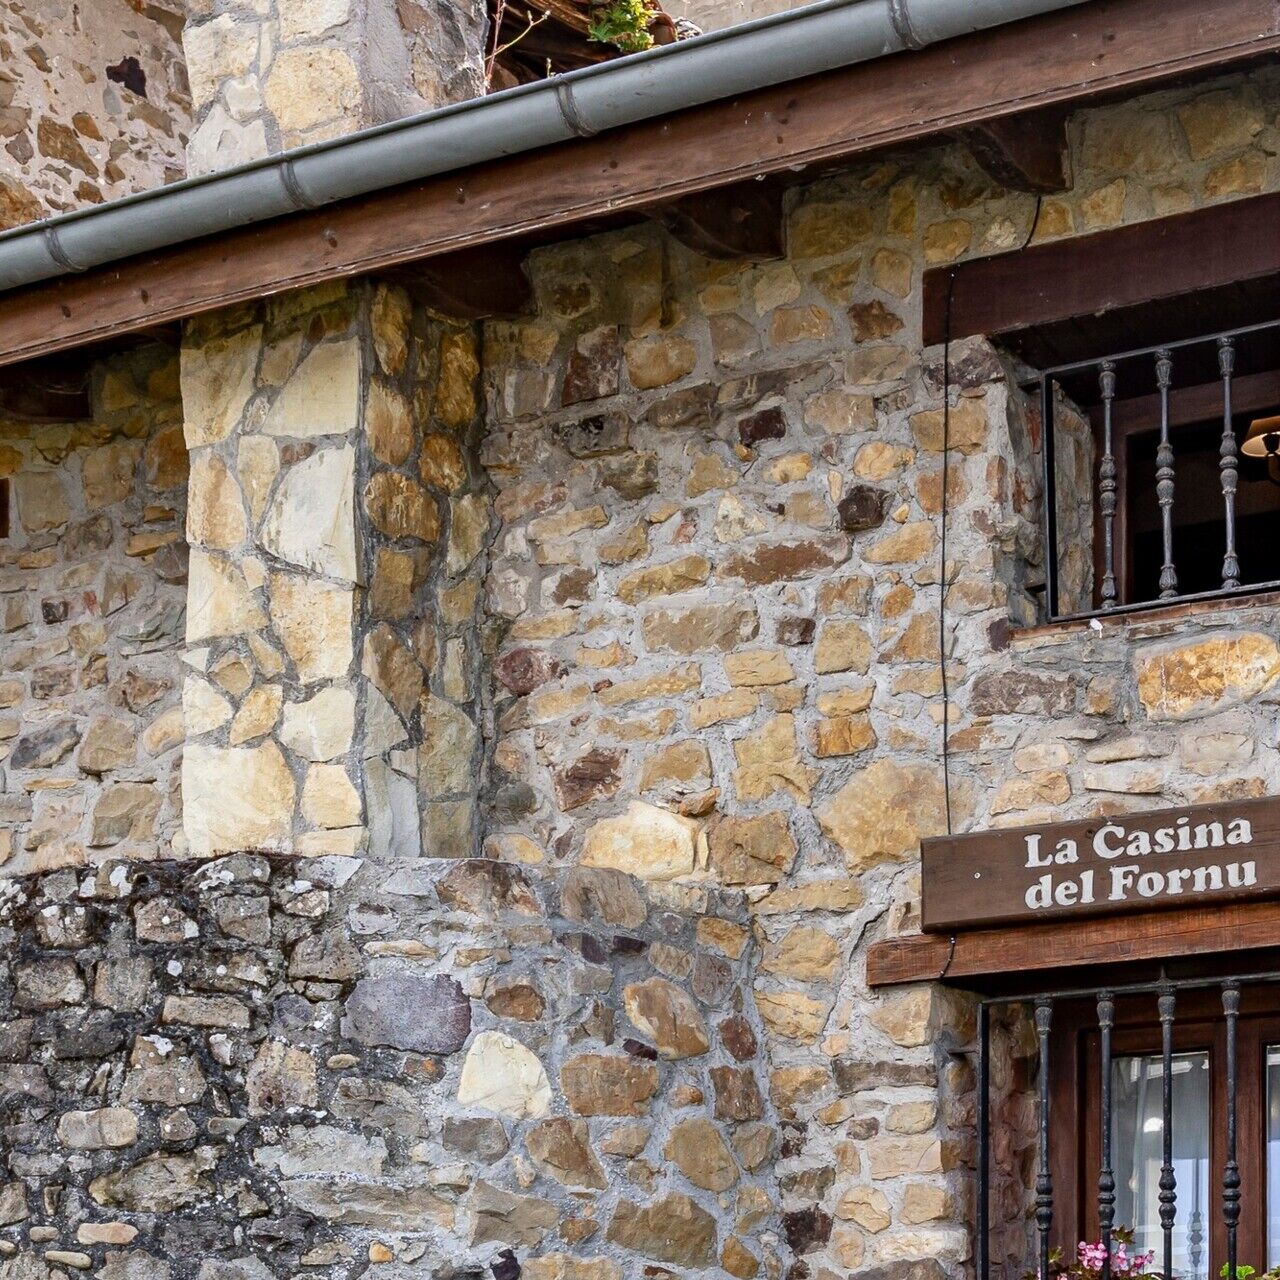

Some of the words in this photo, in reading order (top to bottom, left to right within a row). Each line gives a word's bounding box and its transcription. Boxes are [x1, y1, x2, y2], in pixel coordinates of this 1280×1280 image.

[1023, 833, 1080, 869] La
[1091, 816, 1254, 860] Casina
[1024, 868, 1096, 910] del
[1107, 860, 1259, 901] Fornu
